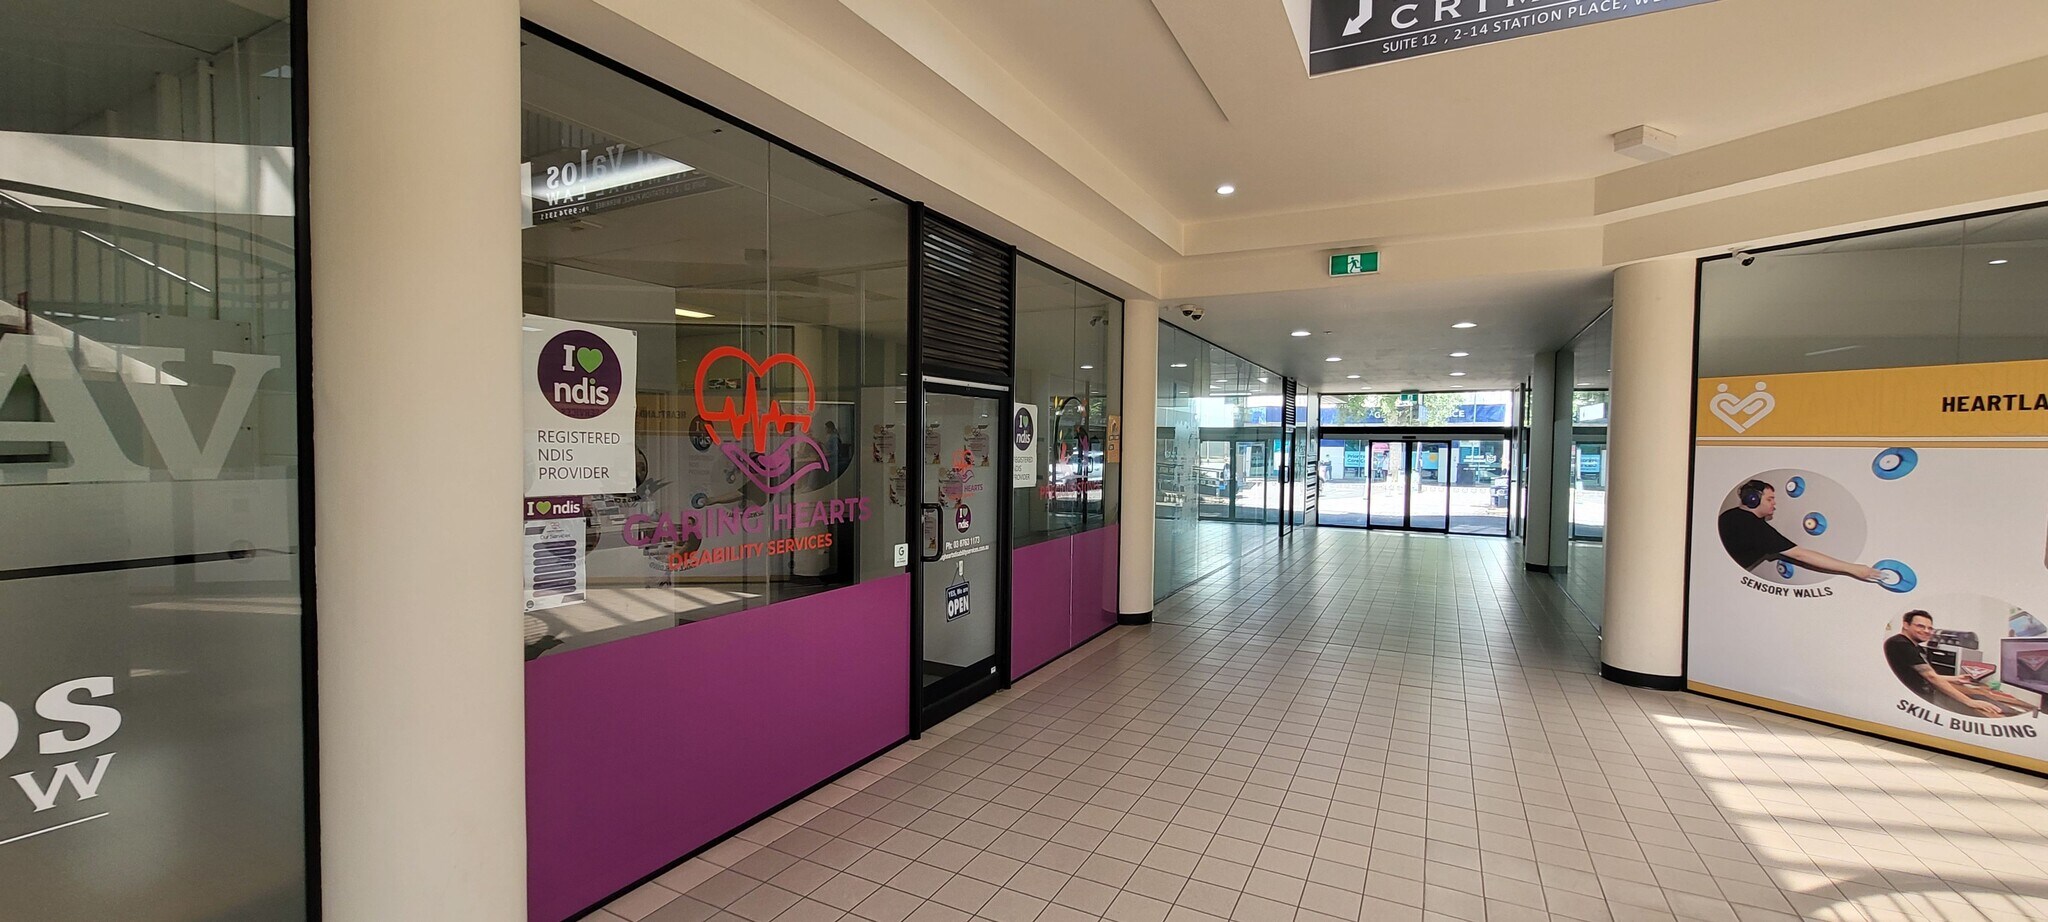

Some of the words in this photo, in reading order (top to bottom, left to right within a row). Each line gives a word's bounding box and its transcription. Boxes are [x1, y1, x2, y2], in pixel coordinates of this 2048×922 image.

[1382, 37, 1418, 54] SUITE
[1422, 33, 1437, 47] 12
[1454, 24, 1489, 41] 2-14
[1493, 9, 1562, 33] STATION
[1568, 0, 1628, 19] PLACE,
[562, 344, 576, 372] I
[553, 377, 610, 406] ndis
[1942, 393, 2048, 412] HEARTLA
[538, 430, 620, 445] REGISTERED
[1016, 430, 1031, 444] ndis
[538, 449, 574, 462] NDIS
[539, 467, 610, 480] PROVIDER
[527, 501, 535, 516] I
[552, 501, 580, 514] ndis
[622, 504, 763, 546] CARING
[773, 497, 872, 532] HEARTS
[668, 542, 763, 572] DISABILITY
[767, 533, 833, 556] SERVICES
[898, 546, 905, 556] G
[1740, 576, 1790, 596] SENSORY
[1793, 586, 1834, 598] WALLS
[948, 595, 969, 617] OPEN
[1896, 699, 1944, 726] SKILL
[1949, 717, 2038, 738] BUILDING
